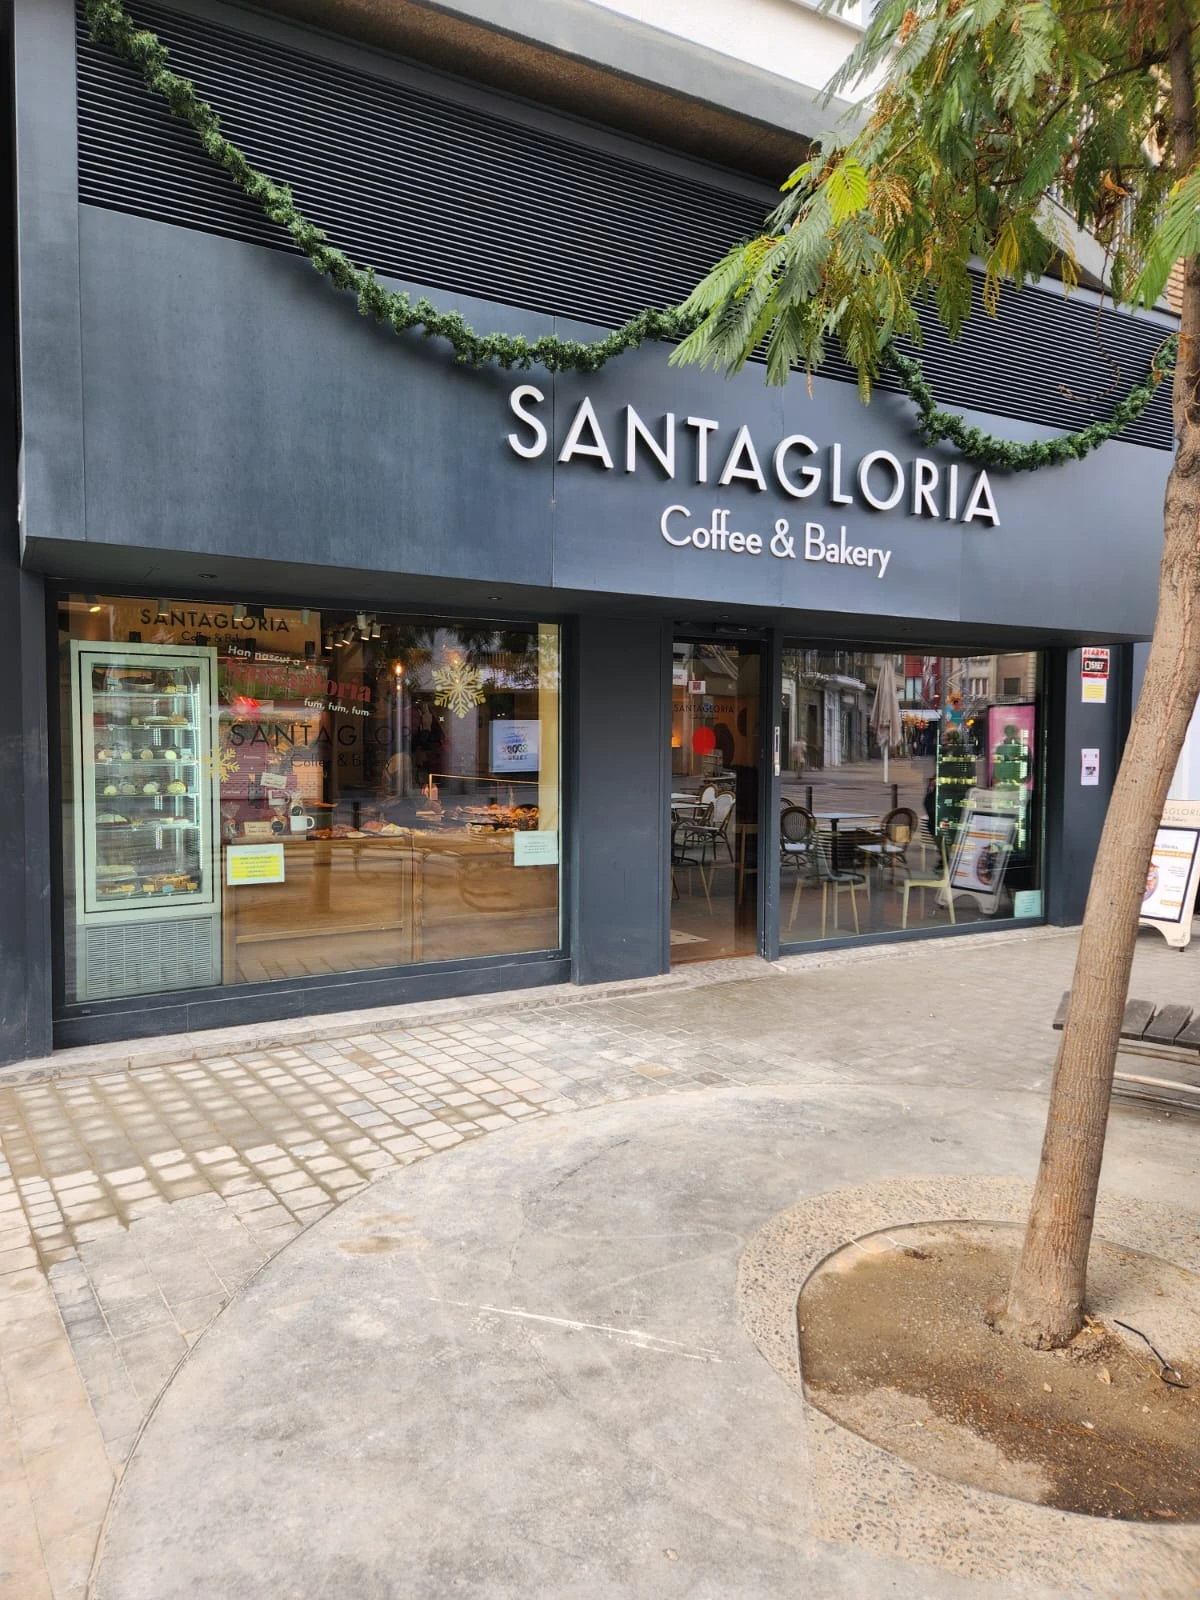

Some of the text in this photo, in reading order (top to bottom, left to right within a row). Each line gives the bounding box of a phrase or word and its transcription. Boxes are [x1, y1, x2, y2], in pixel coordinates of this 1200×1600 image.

[508, 384, 1001, 527] SANTAGLORIA
[660, 504, 892, 579] Coffee & Bakery
[140, 608, 290, 632] SANTAGLORIA
[227, 645, 251, 658] Han
[255, 651, 291, 664] nascut
[304, 697, 370, 717] fum, fum, fum
